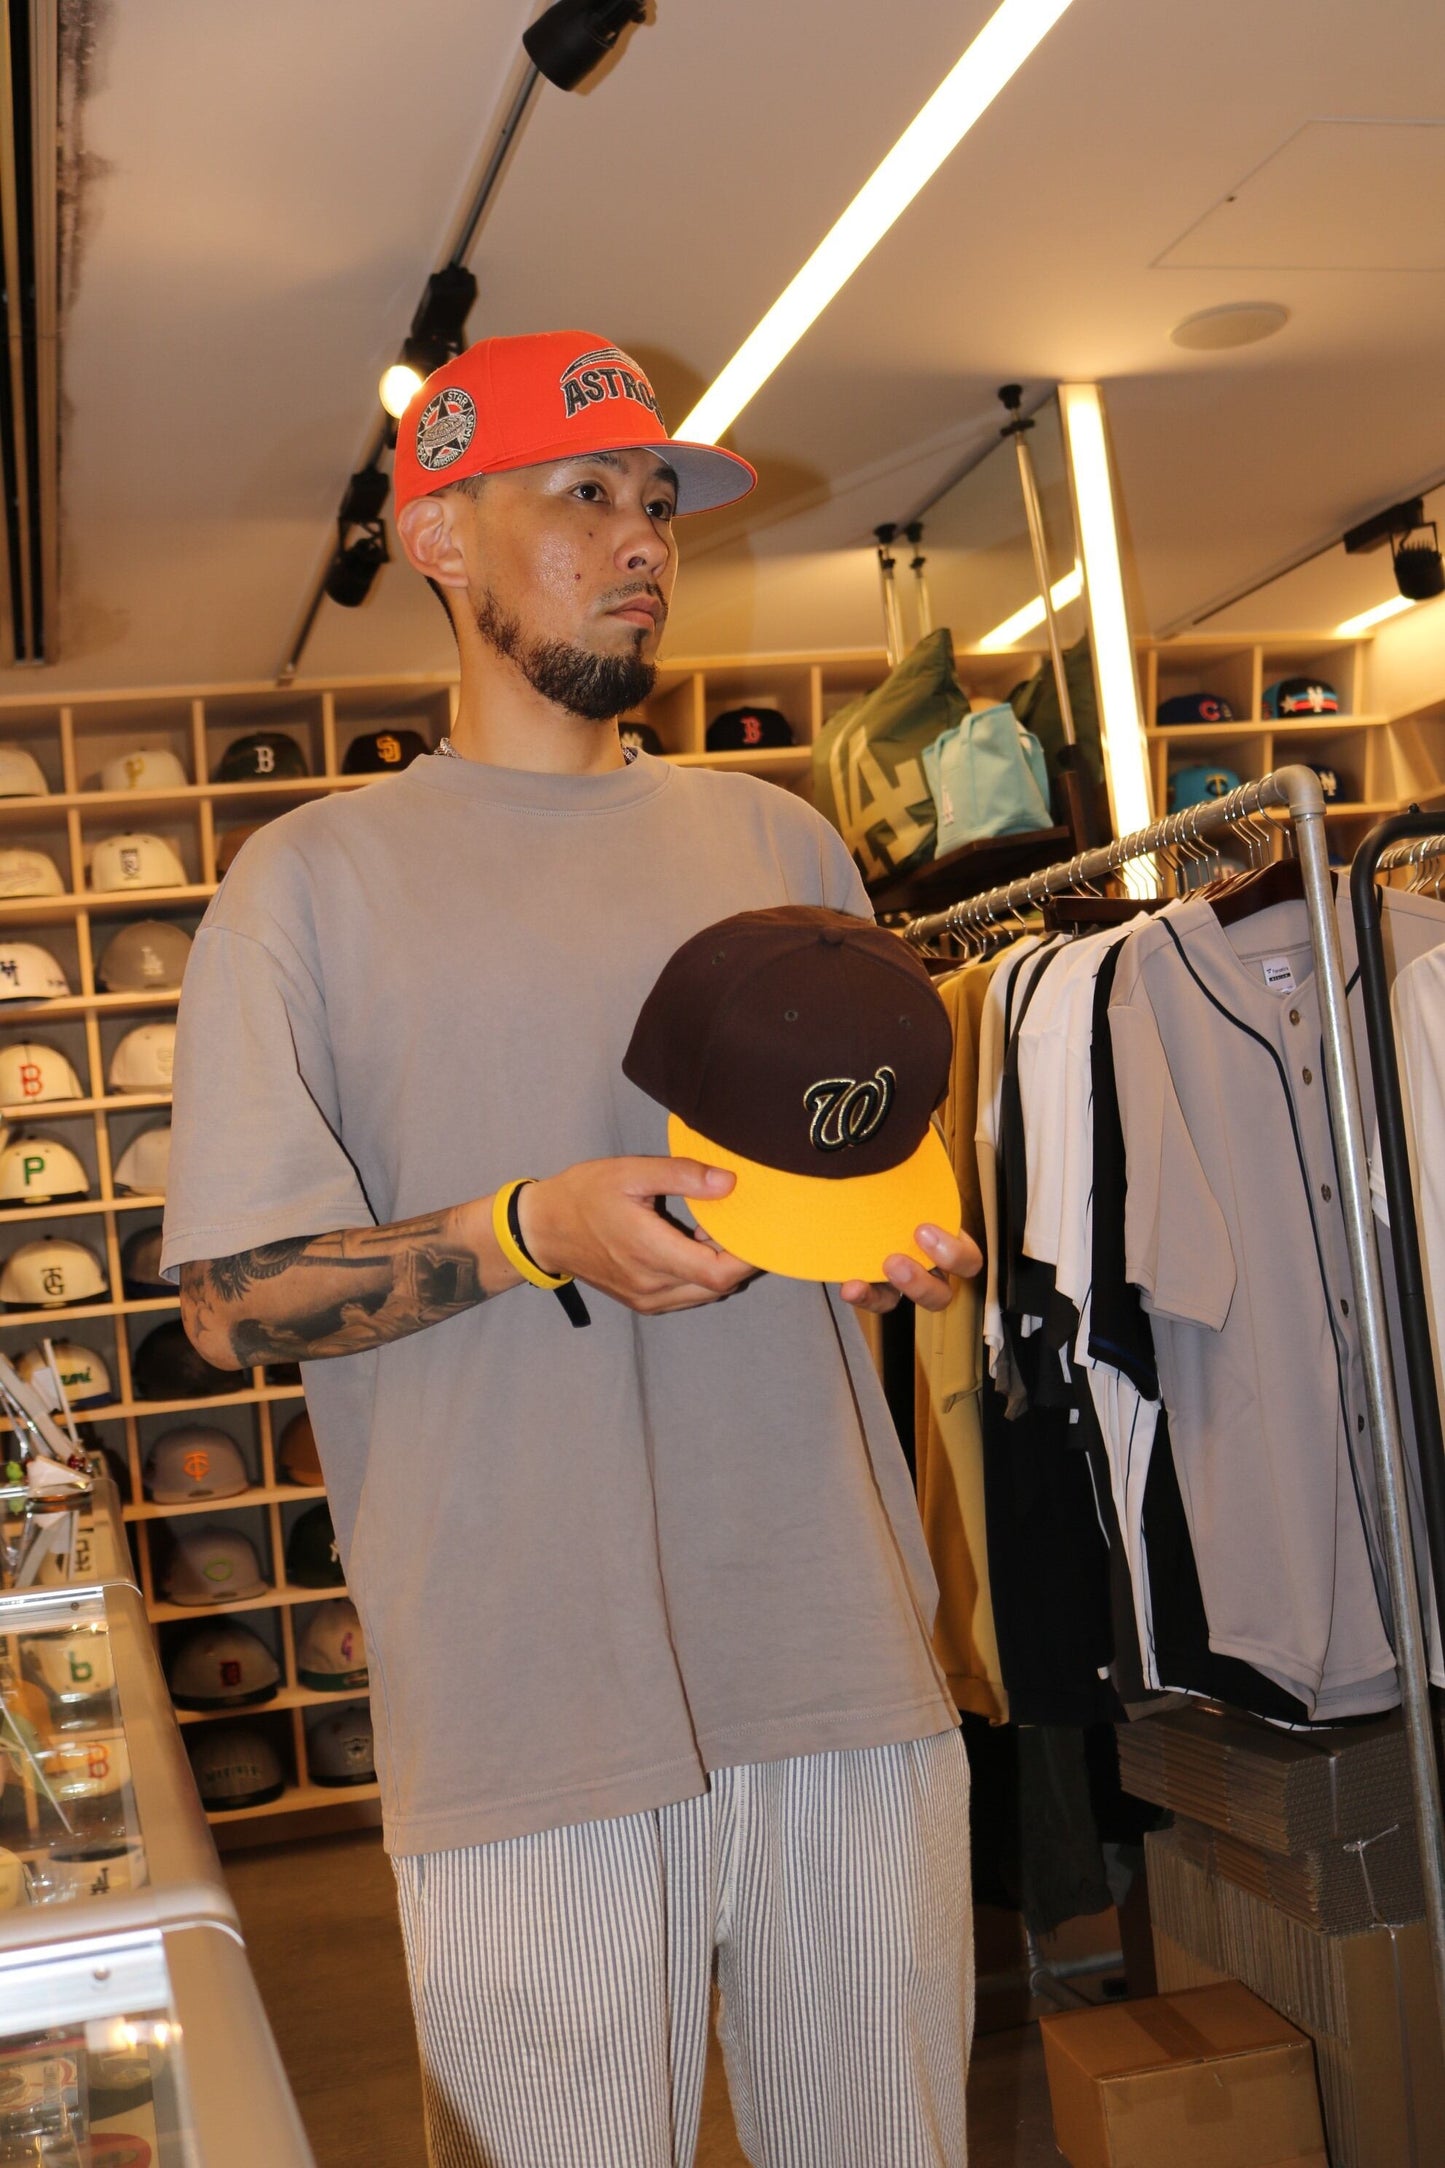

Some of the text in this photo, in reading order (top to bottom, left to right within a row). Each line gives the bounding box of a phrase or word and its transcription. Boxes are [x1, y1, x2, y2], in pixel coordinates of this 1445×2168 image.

[447, 391, 469, 408] STAR
[739, 716, 763, 745] B
[254, 746, 275, 773] B
[19, 1063, 43, 1096] B
[803, 1066, 896, 1152] W
[23, 1156, 45, 1186] P
